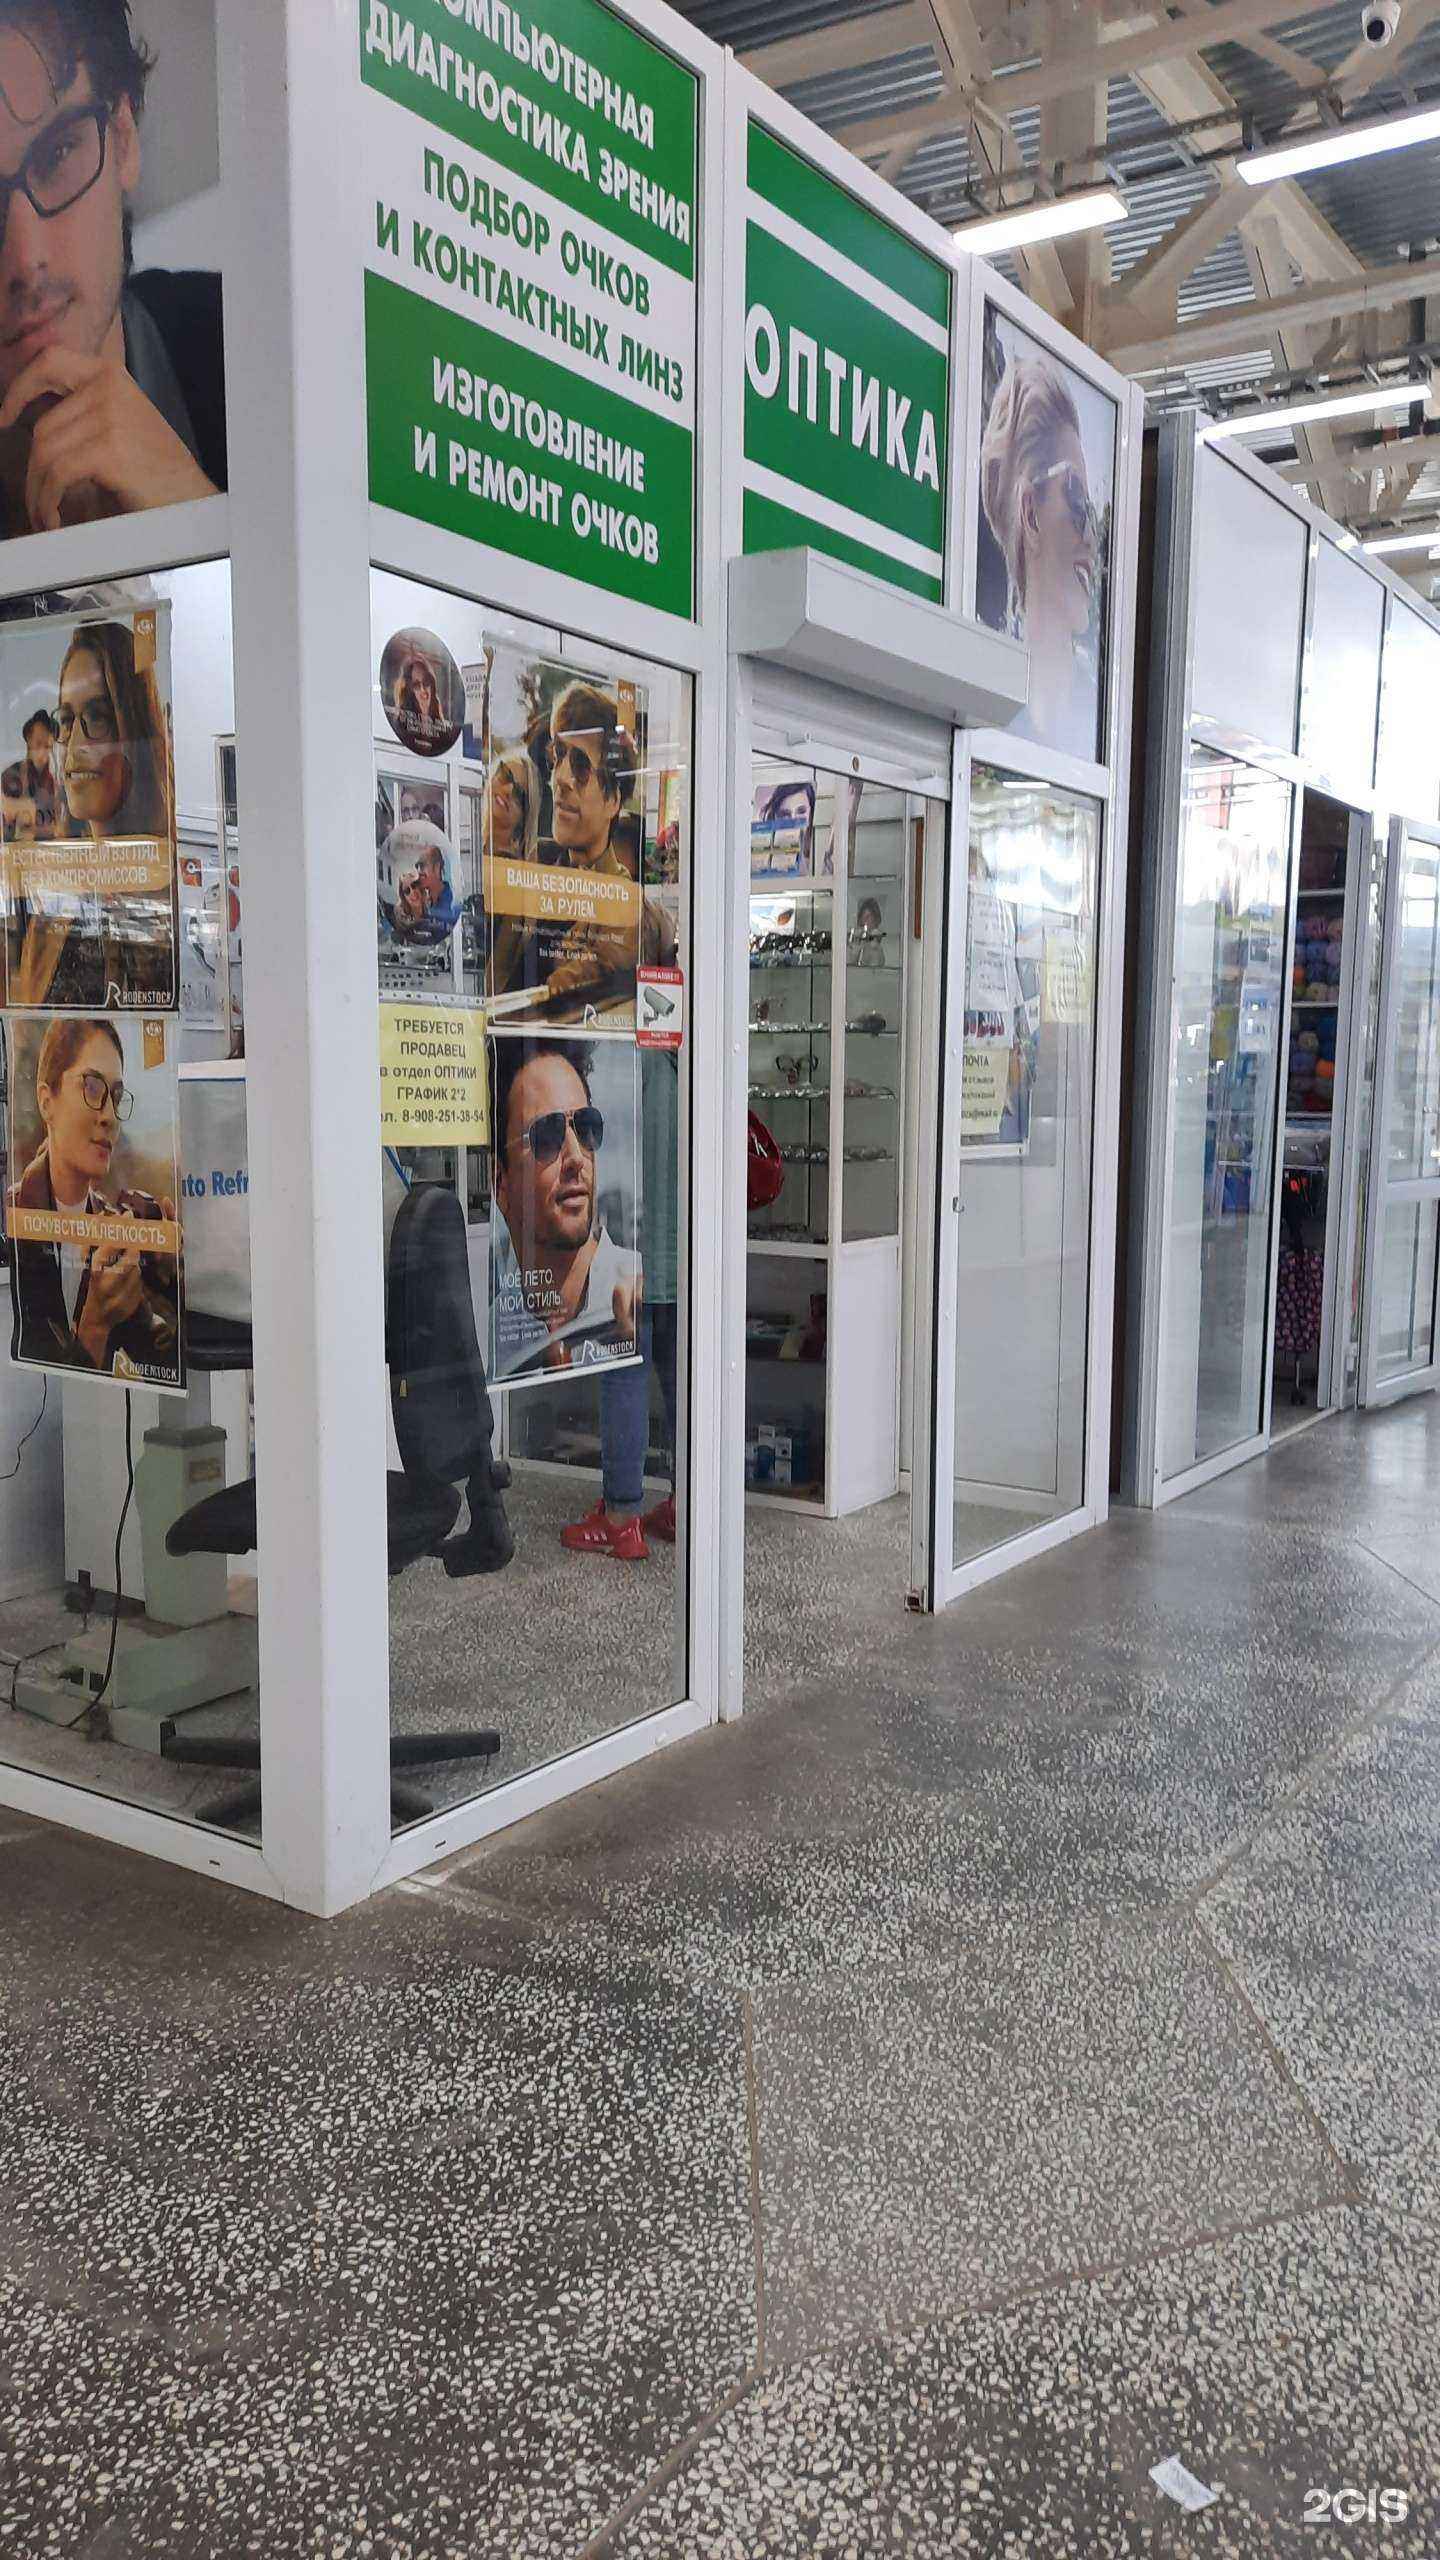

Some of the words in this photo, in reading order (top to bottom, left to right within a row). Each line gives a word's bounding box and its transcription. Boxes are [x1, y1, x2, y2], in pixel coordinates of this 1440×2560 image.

[365, 1, 591, 182] ДИАГНОСТИКА
[598, 148, 690, 246] ЗРЕНИЯ
[433, 0, 654, 150] МПЬЮТЕРНАЯ
[423, 147, 550, 256] ПОДБОР
[560, 230, 650, 316] ОЧКОВ
[376, 201, 399, 256] И
[413, 220, 609, 365] КОНТАКТНЫХ
[618, 333, 683, 403] ЛИНЗ
[433, 355, 645, 493] ИЗГОТОВЛЕНИЕ
[745, 303, 940, 492] ОПТИКА
[414, 425, 436, 478] И
[449, 440, 563, 526] РЕМОНТ
[571, 493, 659, 565] ОЧКОВ
[507, 868, 539, 890] ВАША
[542, 873, 629, 902] БЕЗОПАСНОСТЬ
[393, 1067, 431, 1080] отдел
[434, 1065, 477, 1080] ОПТИКИ
[394, 1019, 464, 1035] ТРЕБУЕТСЯ
[397, 1086, 448, 1101] ГРАФИК
[400, 1042, 466, 1059] ПРОДАВЕЦ
